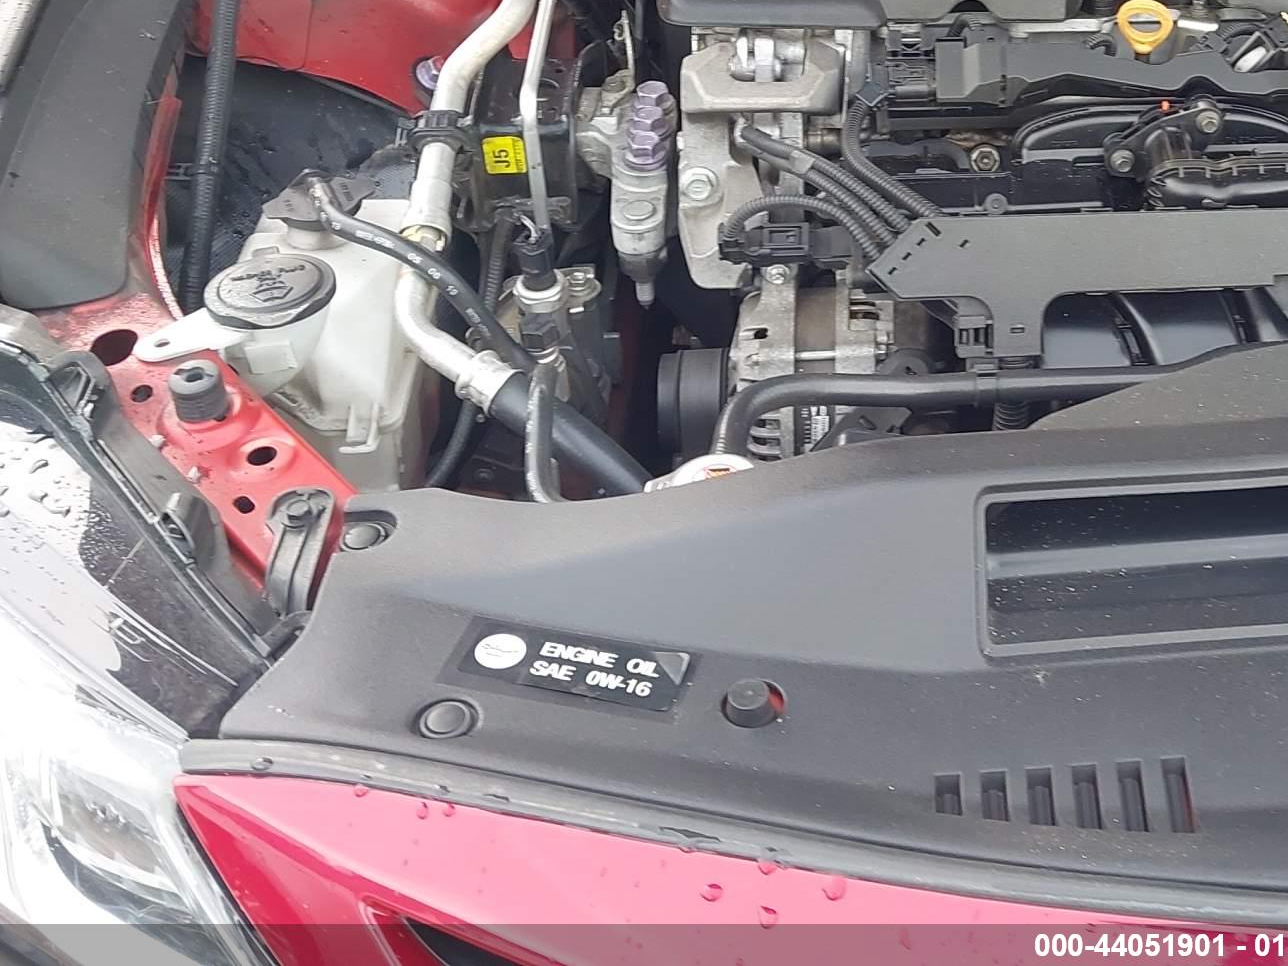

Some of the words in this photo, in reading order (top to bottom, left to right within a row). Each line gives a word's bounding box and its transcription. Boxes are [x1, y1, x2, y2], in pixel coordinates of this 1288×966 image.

[529, 660, 577, 682] SAE
[585, 670, 654, 698] 0W-16
[539, 641, 620, 669] ENGINE
[626, 658, 660, 679] OIL
